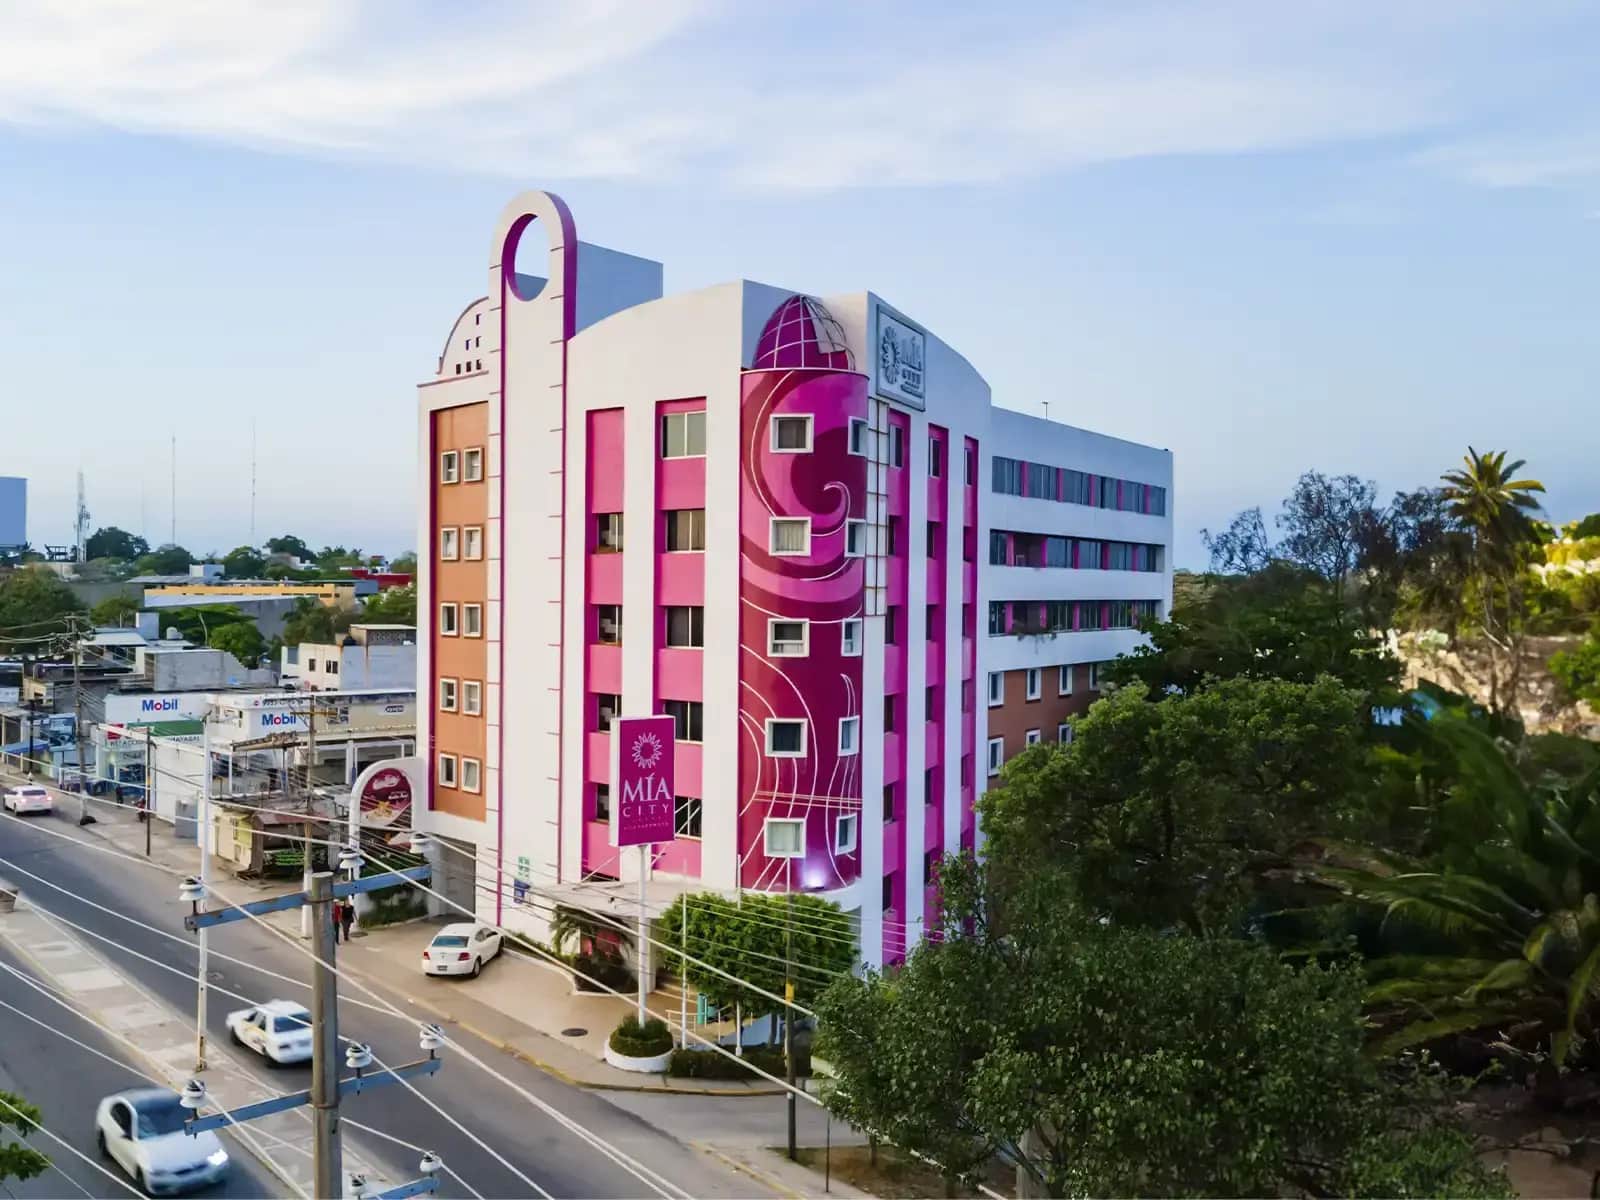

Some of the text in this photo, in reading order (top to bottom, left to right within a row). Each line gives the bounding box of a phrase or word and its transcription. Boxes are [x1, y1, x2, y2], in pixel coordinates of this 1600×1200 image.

[141, 699, 178, 712] Mobil
[262, 713, 296, 726] Mobil
[622, 773, 672, 803] MÍA
[623, 803, 671, 817] CITY
